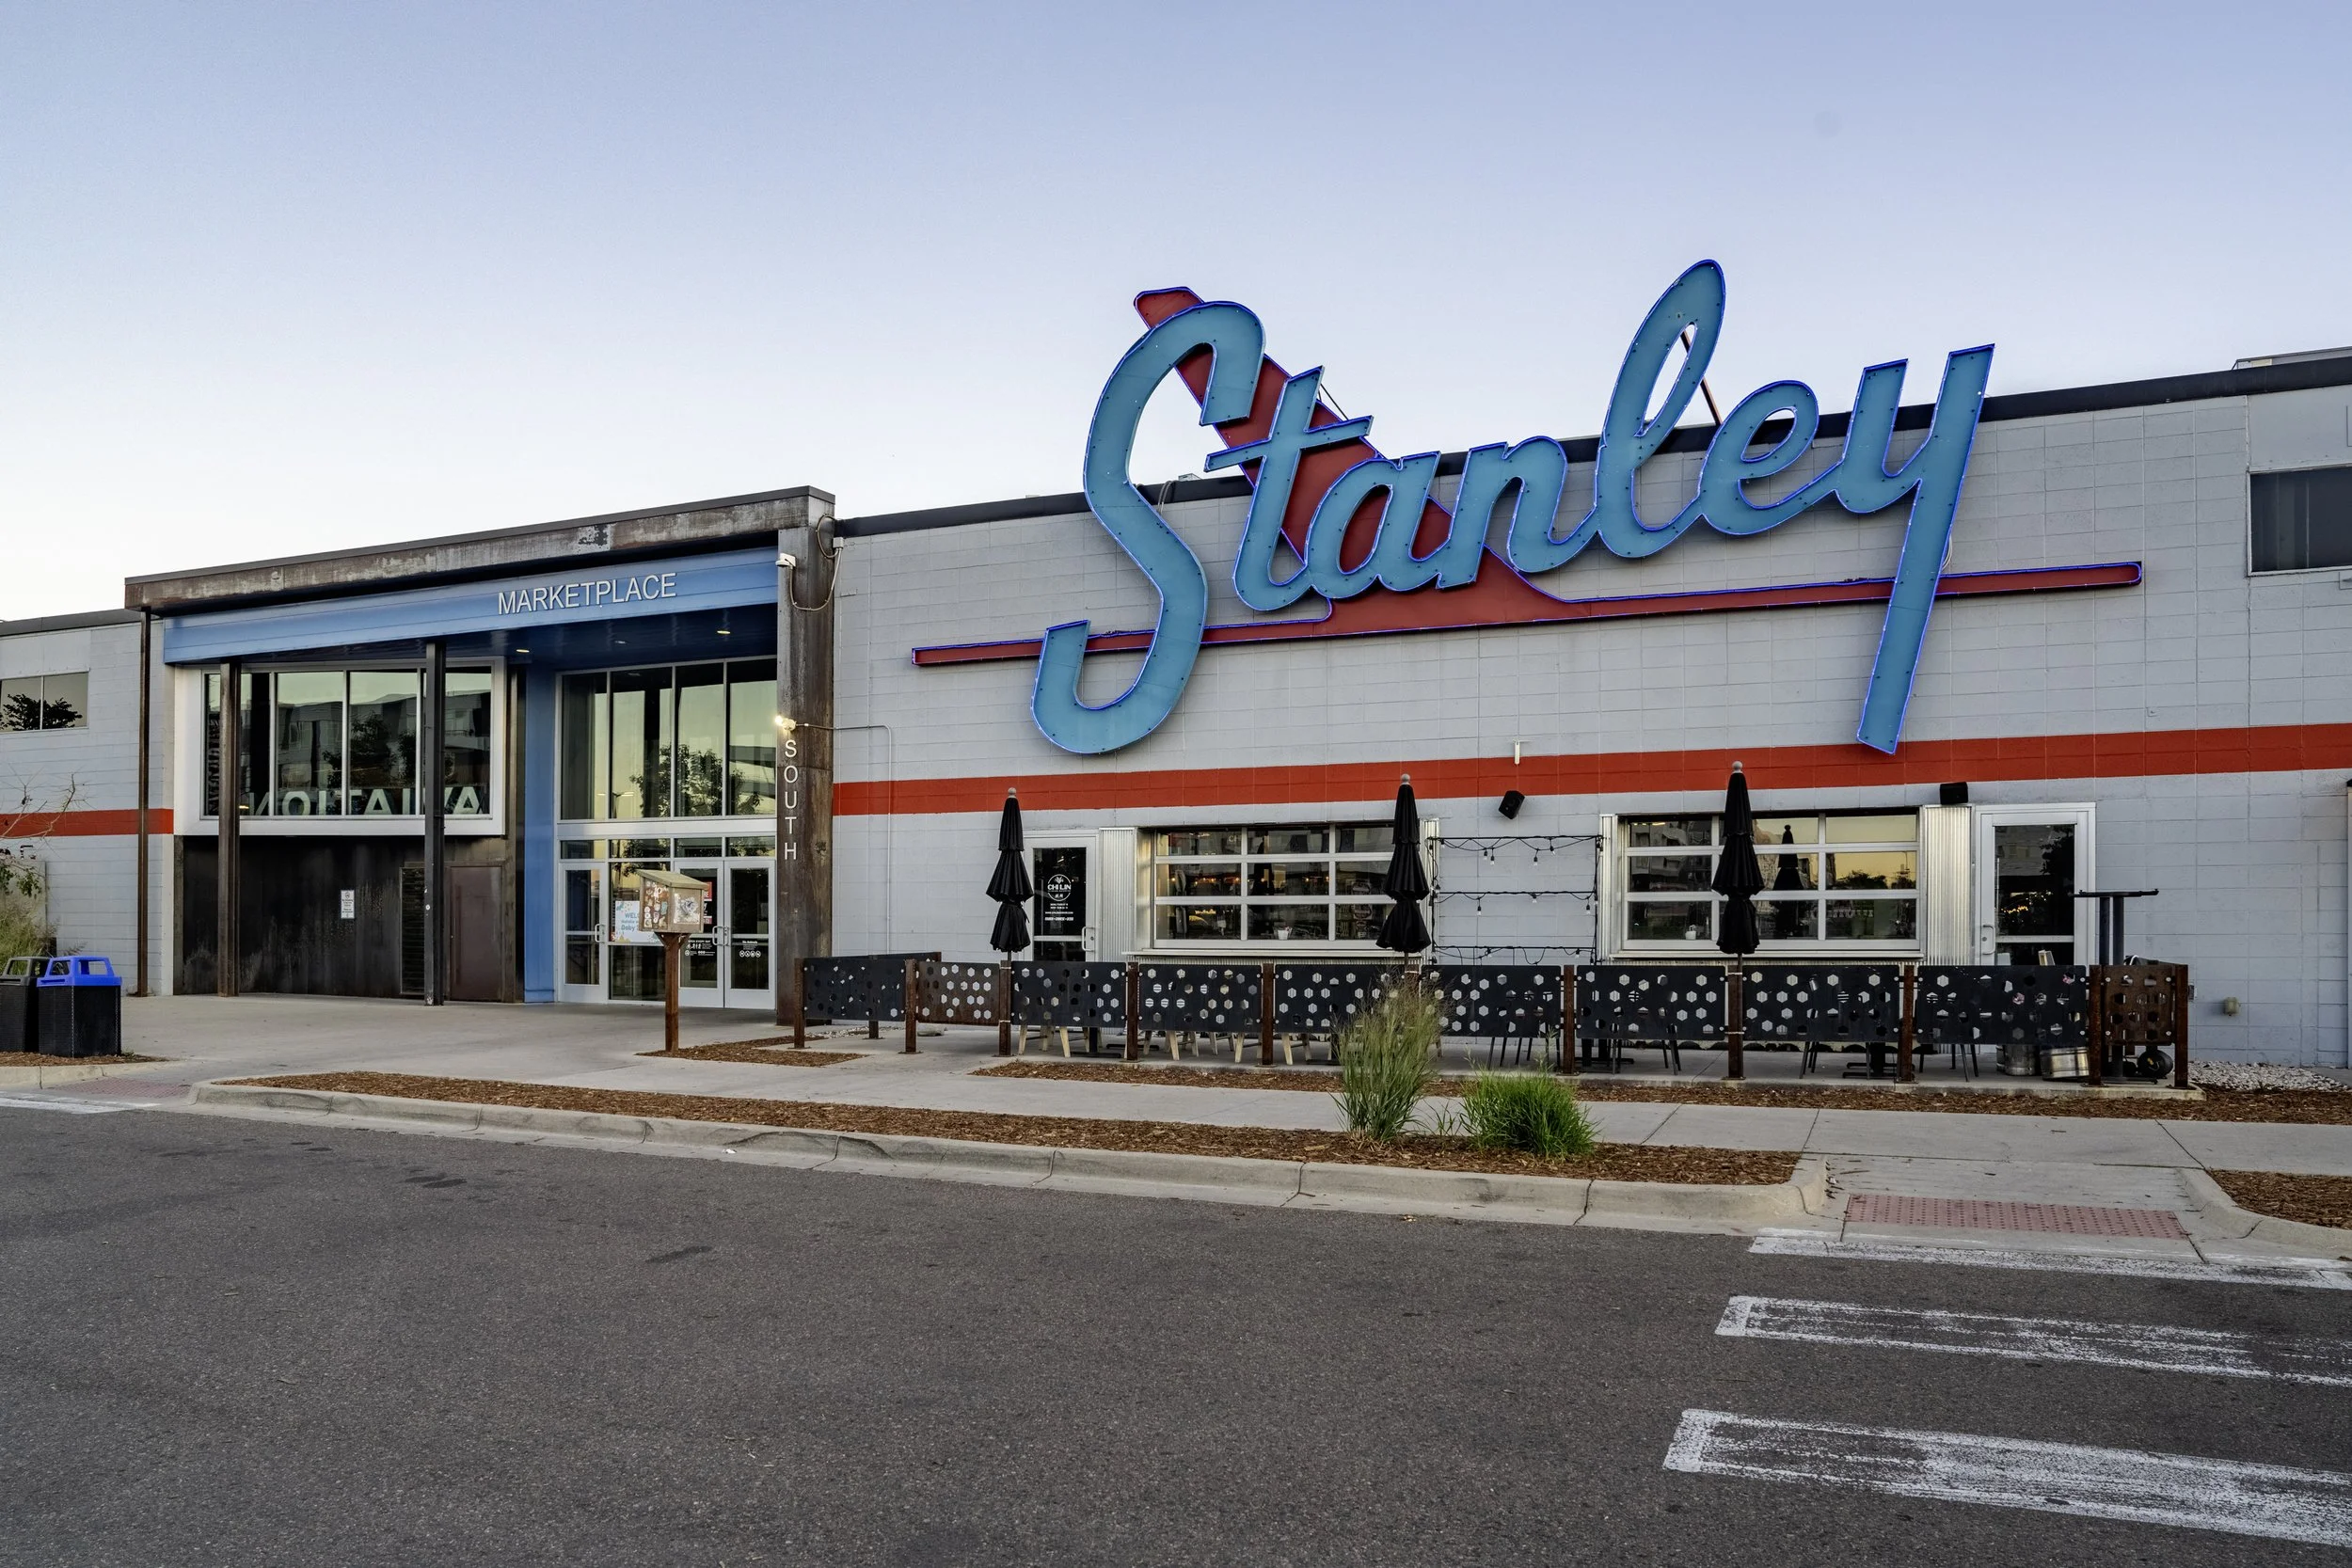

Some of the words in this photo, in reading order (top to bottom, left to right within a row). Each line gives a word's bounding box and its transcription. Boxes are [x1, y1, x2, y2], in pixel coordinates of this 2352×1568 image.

[1030, 259, 1995, 754] Stanley
[498, 573, 676, 615] MARKETPLACE
[784, 739, 799, 860] SOUTH
